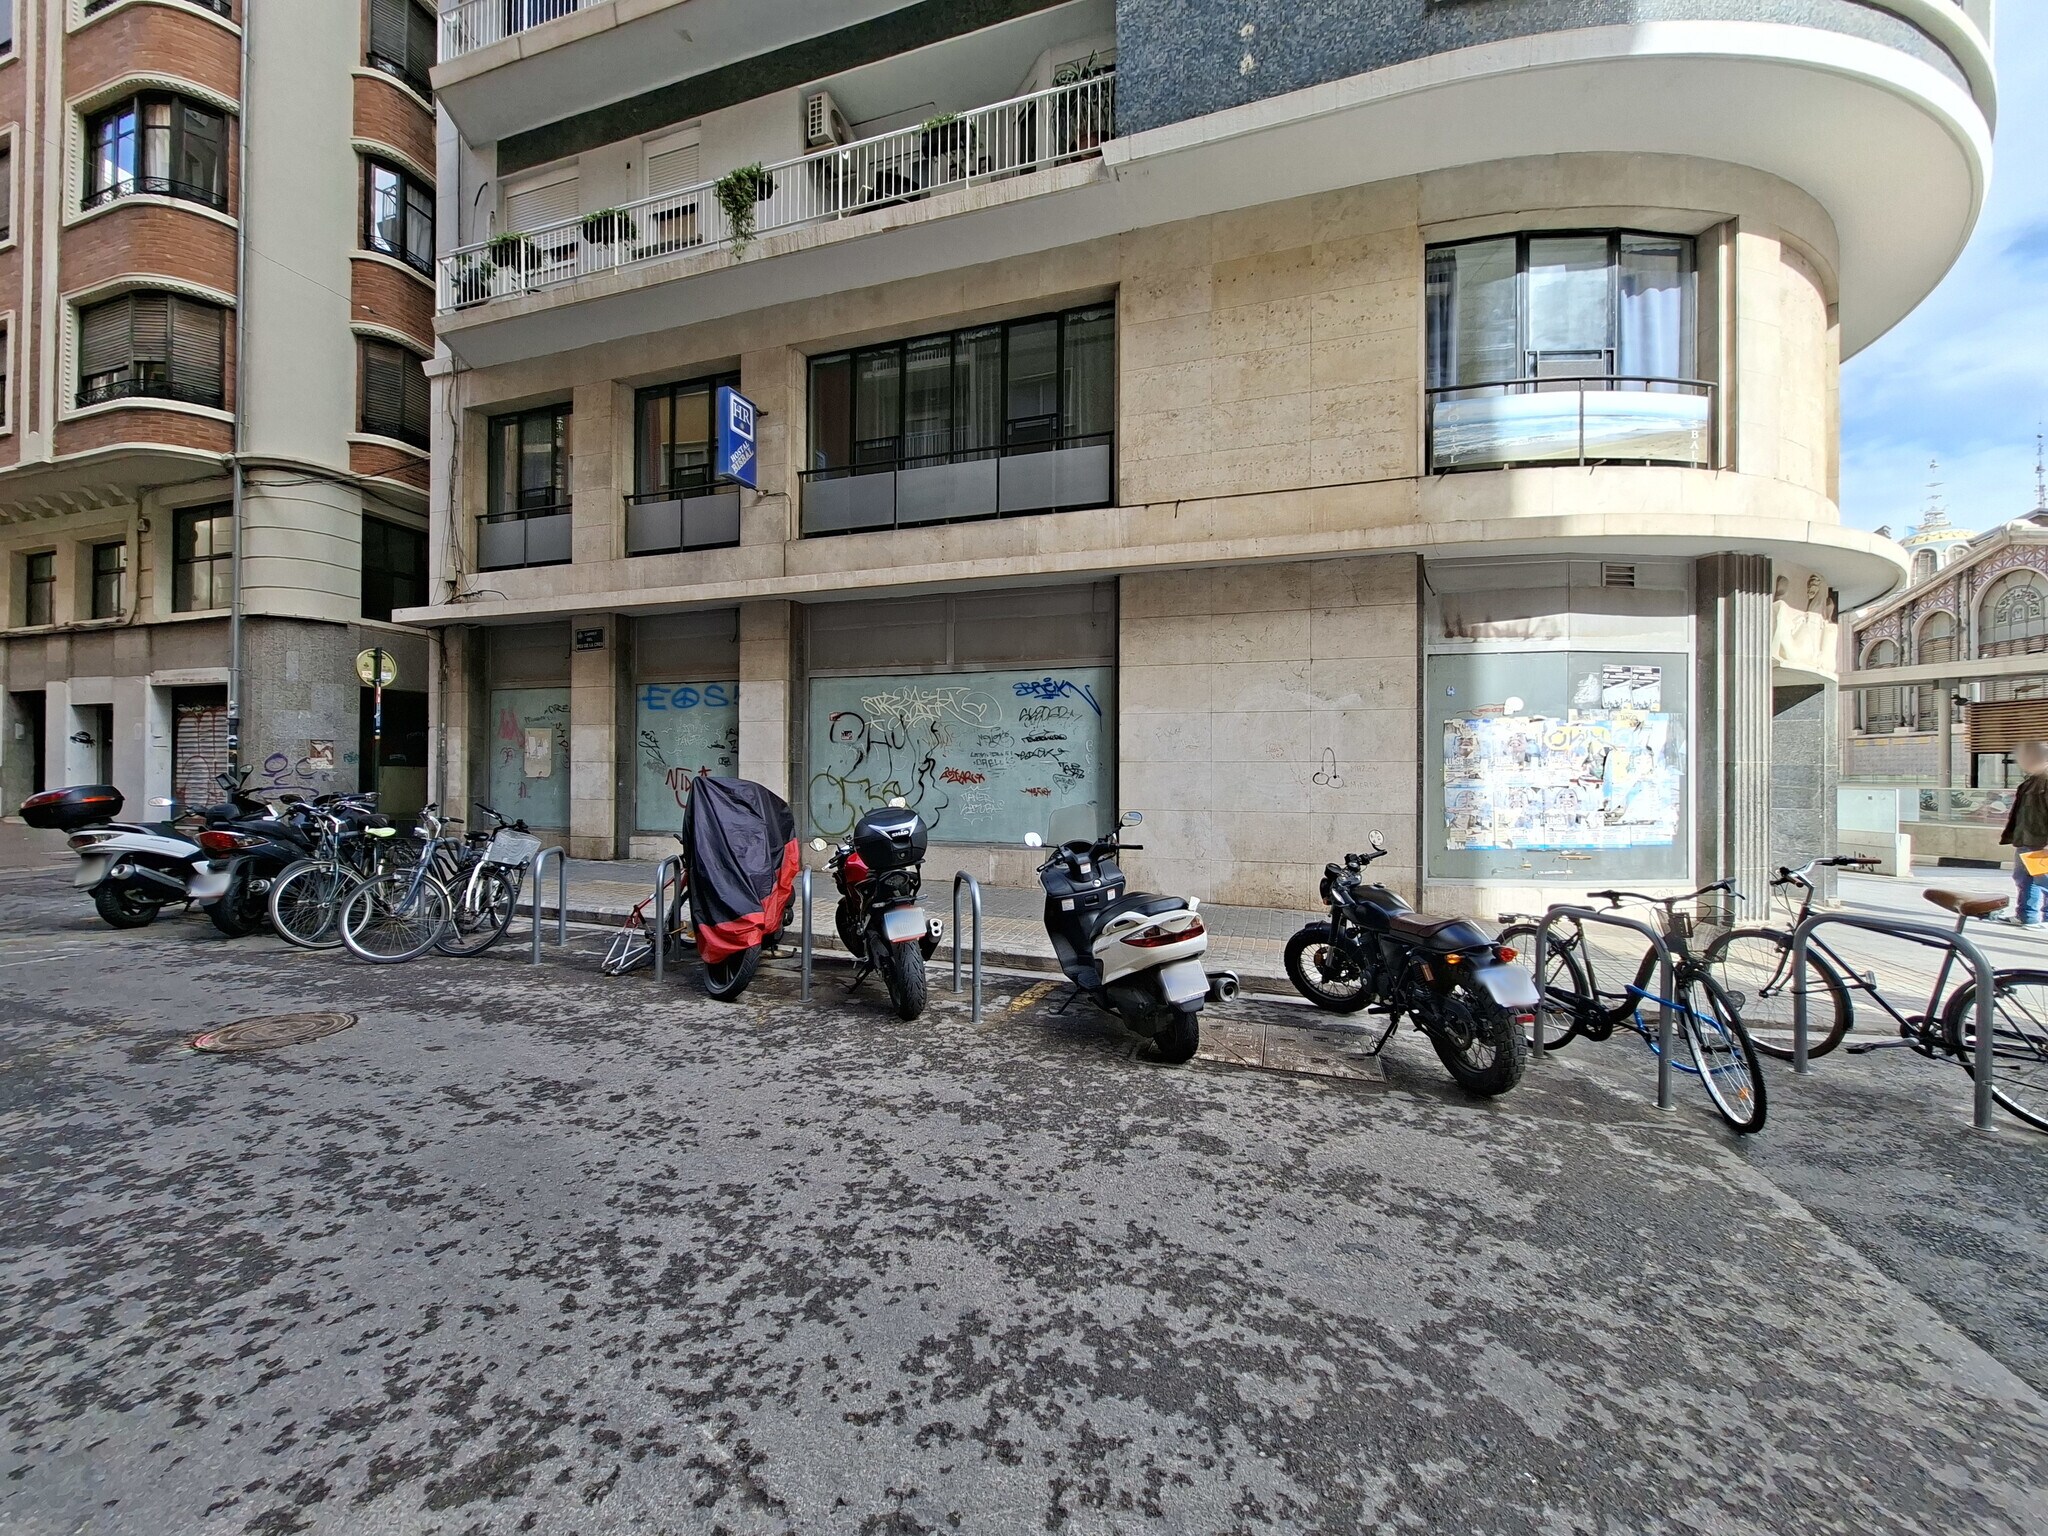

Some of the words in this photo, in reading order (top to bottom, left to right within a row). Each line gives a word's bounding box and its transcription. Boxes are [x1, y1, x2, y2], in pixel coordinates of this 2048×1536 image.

[733, 402, 751, 424] HR
[730, 441, 750, 463] HOSTAL
[891, 829, 909, 837] SHAD
